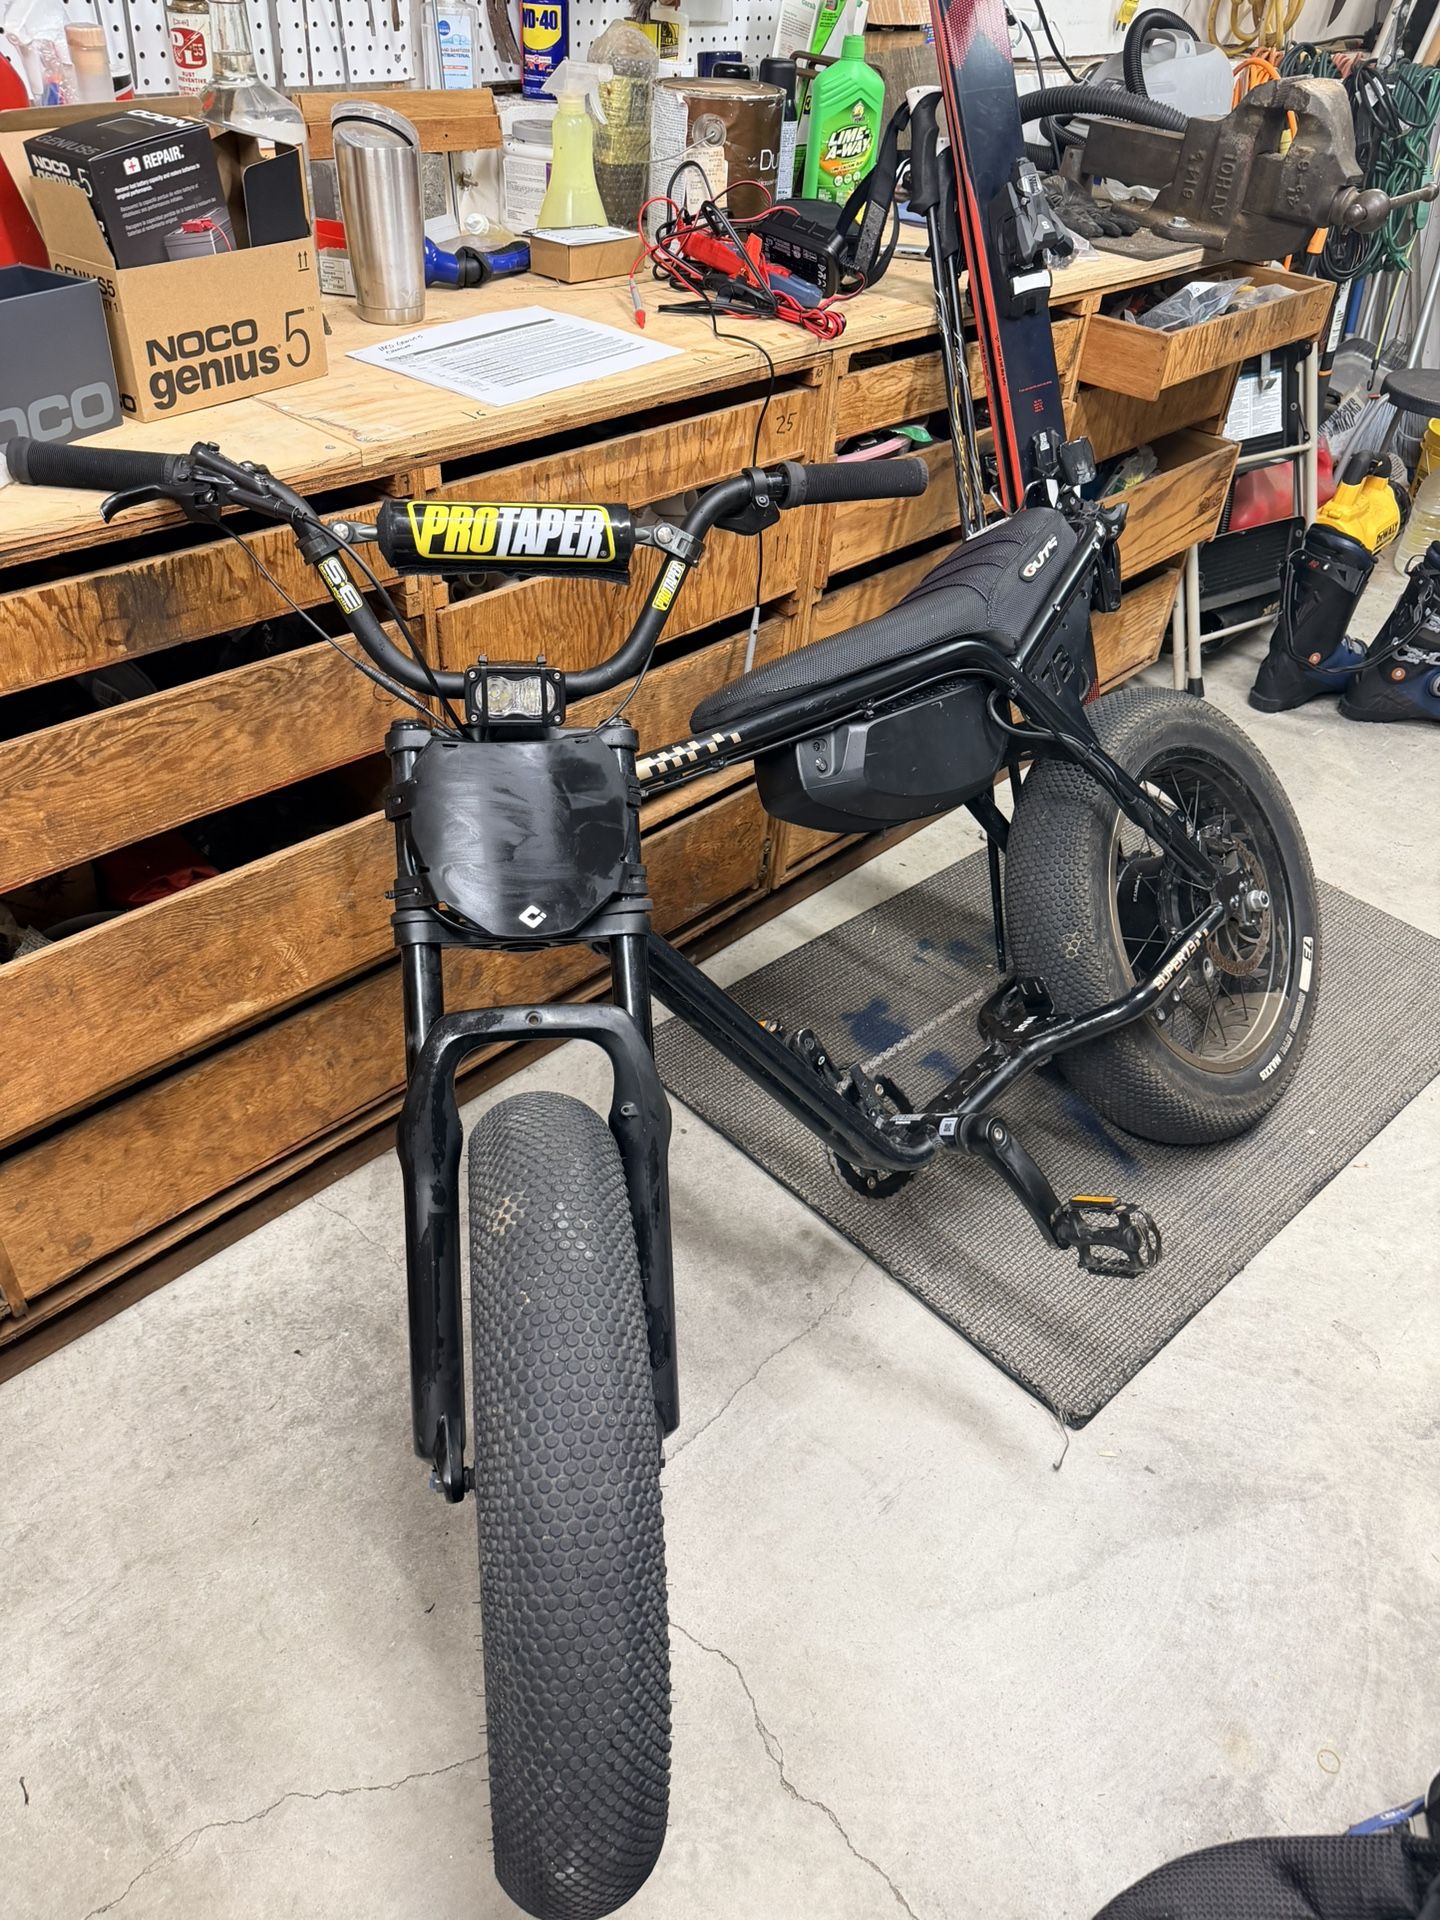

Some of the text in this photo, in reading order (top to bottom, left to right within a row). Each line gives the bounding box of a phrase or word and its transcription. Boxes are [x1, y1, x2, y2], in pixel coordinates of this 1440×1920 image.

[31, 154, 71, 177] NOCO
[146, 319, 258, 366] NOCO
[150, 344, 281, 410] genius
[285, 308, 311, 367] 5
[776, 412, 797, 434] 25
[420, 505, 607, 559] PROTAPER
[1022, 536, 1058, 577] GUTS
[1153, 940, 1197, 991] SUPER73
[1259, 1053, 1282, 1080] MAXXIS
